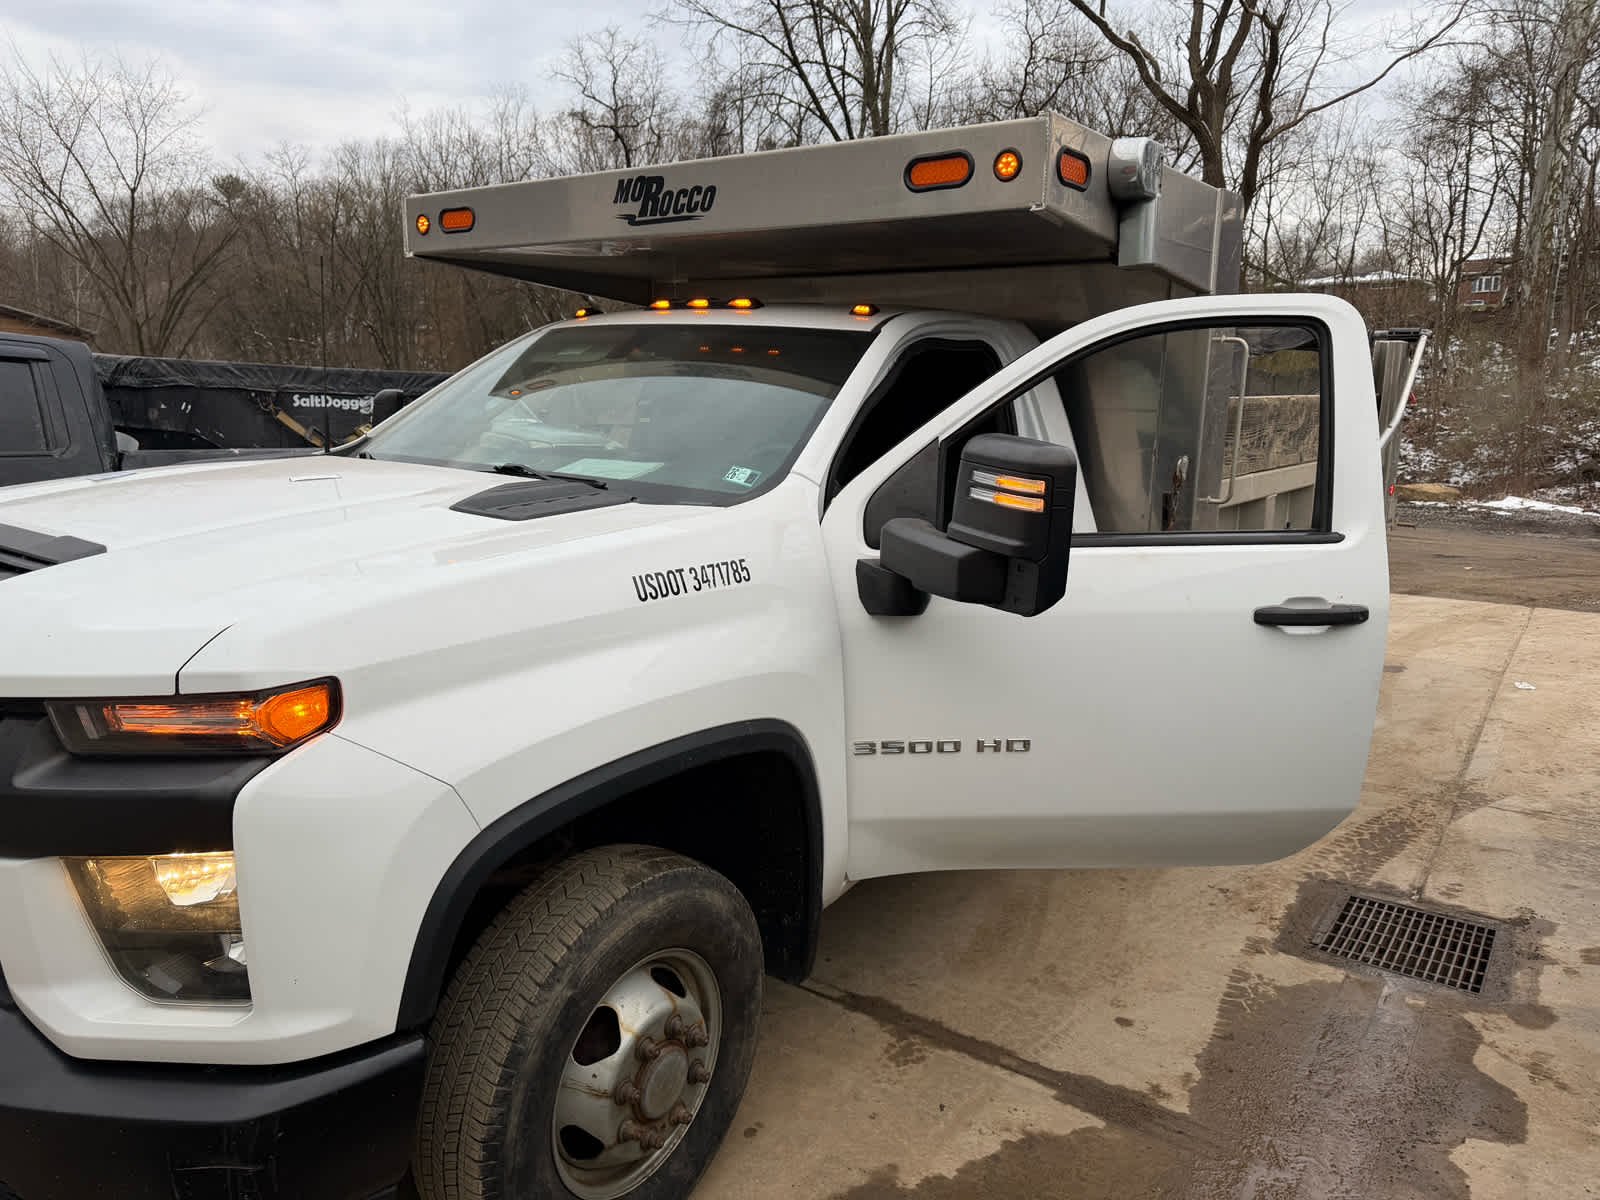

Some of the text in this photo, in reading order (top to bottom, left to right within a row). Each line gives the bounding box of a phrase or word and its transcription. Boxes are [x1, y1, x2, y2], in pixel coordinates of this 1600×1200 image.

[632, 559, 751, 602] USDOT 3471785
[853, 738, 1031, 756] 3500 HD
